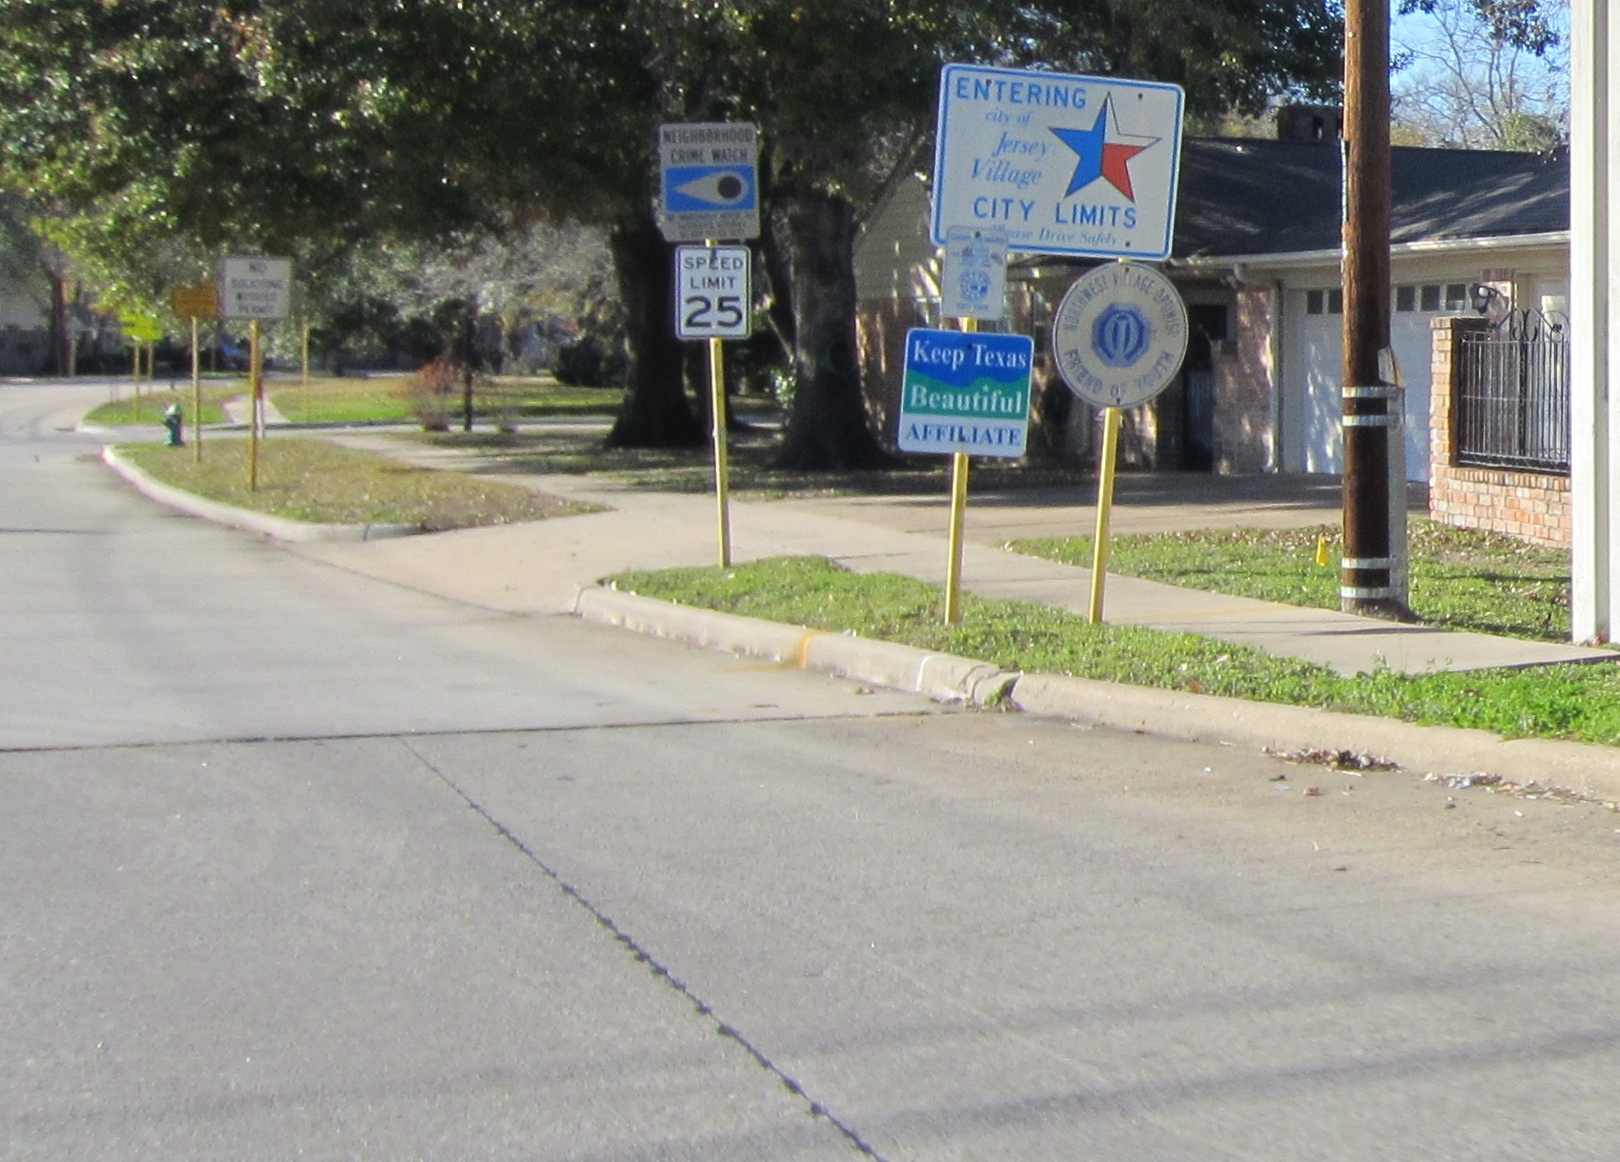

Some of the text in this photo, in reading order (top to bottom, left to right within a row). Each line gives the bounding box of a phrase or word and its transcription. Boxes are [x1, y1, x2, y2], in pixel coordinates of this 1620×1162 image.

[956, 76, 1087, 109] ENTERING
[985, 108, 1032, 125] city of
[662, 129, 754, 144] NEIGHBORHOOD
[992, 132, 1049, 158] Jersey
[711, 147, 748, 163] WATCH
[970, 157, 1042, 188] Village
[973, 196, 1137, 229] CITY LIMITS
[683, 256, 744, 270] SPEED
[690, 276, 736, 290] LIMIT
[684, 295, 743, 328] 25
[913, 340, 1027, 370] Keep Texas
[909, 384, 1022, 415] Beautiful
[906, 423, 1021, 447] AFFILIATE
